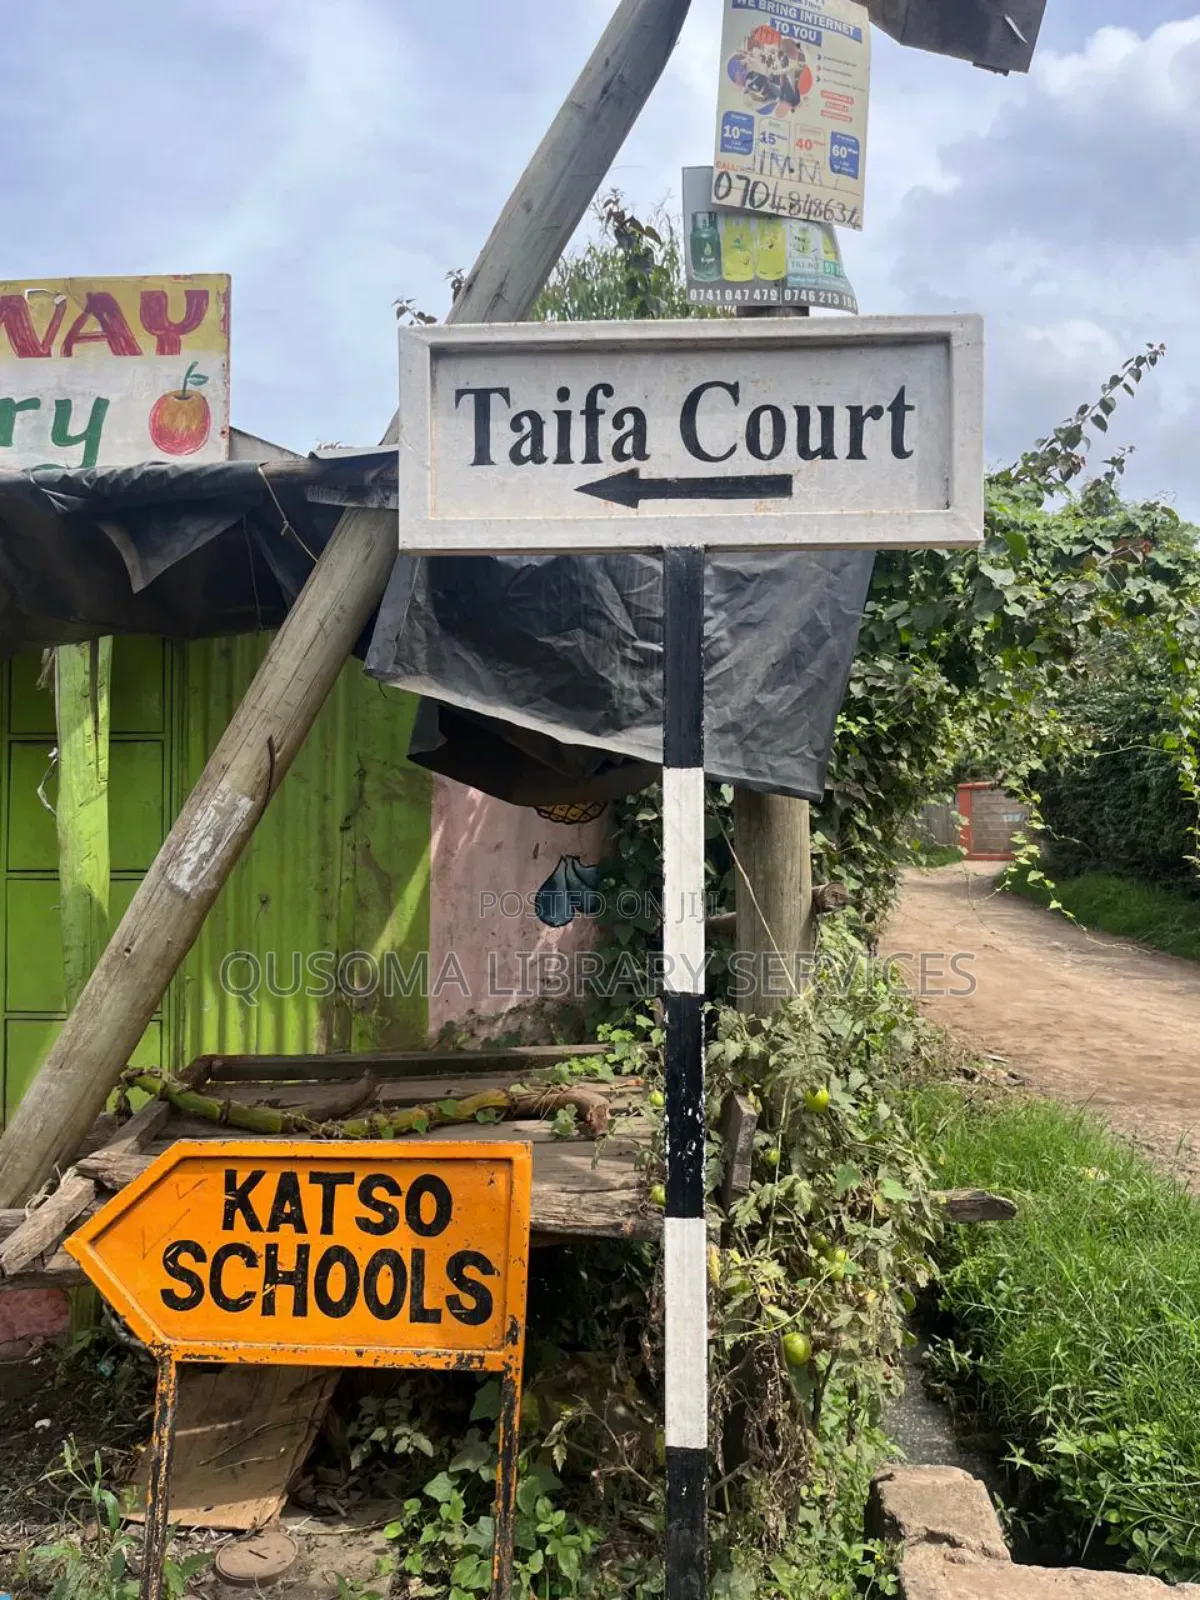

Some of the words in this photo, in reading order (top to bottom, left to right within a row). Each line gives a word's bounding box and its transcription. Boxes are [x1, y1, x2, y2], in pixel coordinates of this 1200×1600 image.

[759, 0, 797, 18] BRING
[800, 9, 856, 36] INTERNET
[775, 20, 789, 33] TO
[794, 25, 817, 41] YOU
[723, 124, 740, 140] 10
[760, 130, 776, 145] 15
[795, 138, 813, 151] 40
[832, 144, 848, 159] 60
[714, 170, 861, 230] 0704848634
[690, 289, 721, 301] 0741
[725, 289, 750, 301] 047
[784, 289, 816, 302] 0746
[819, 291, 840, 305] 213
[455, 383, 651, 466] Taifa
[679, 380, 916, 462] Court
[222, 1168, 452, 1238] KATSO
[159, 1239, 500, 1326] SCHOOLS
